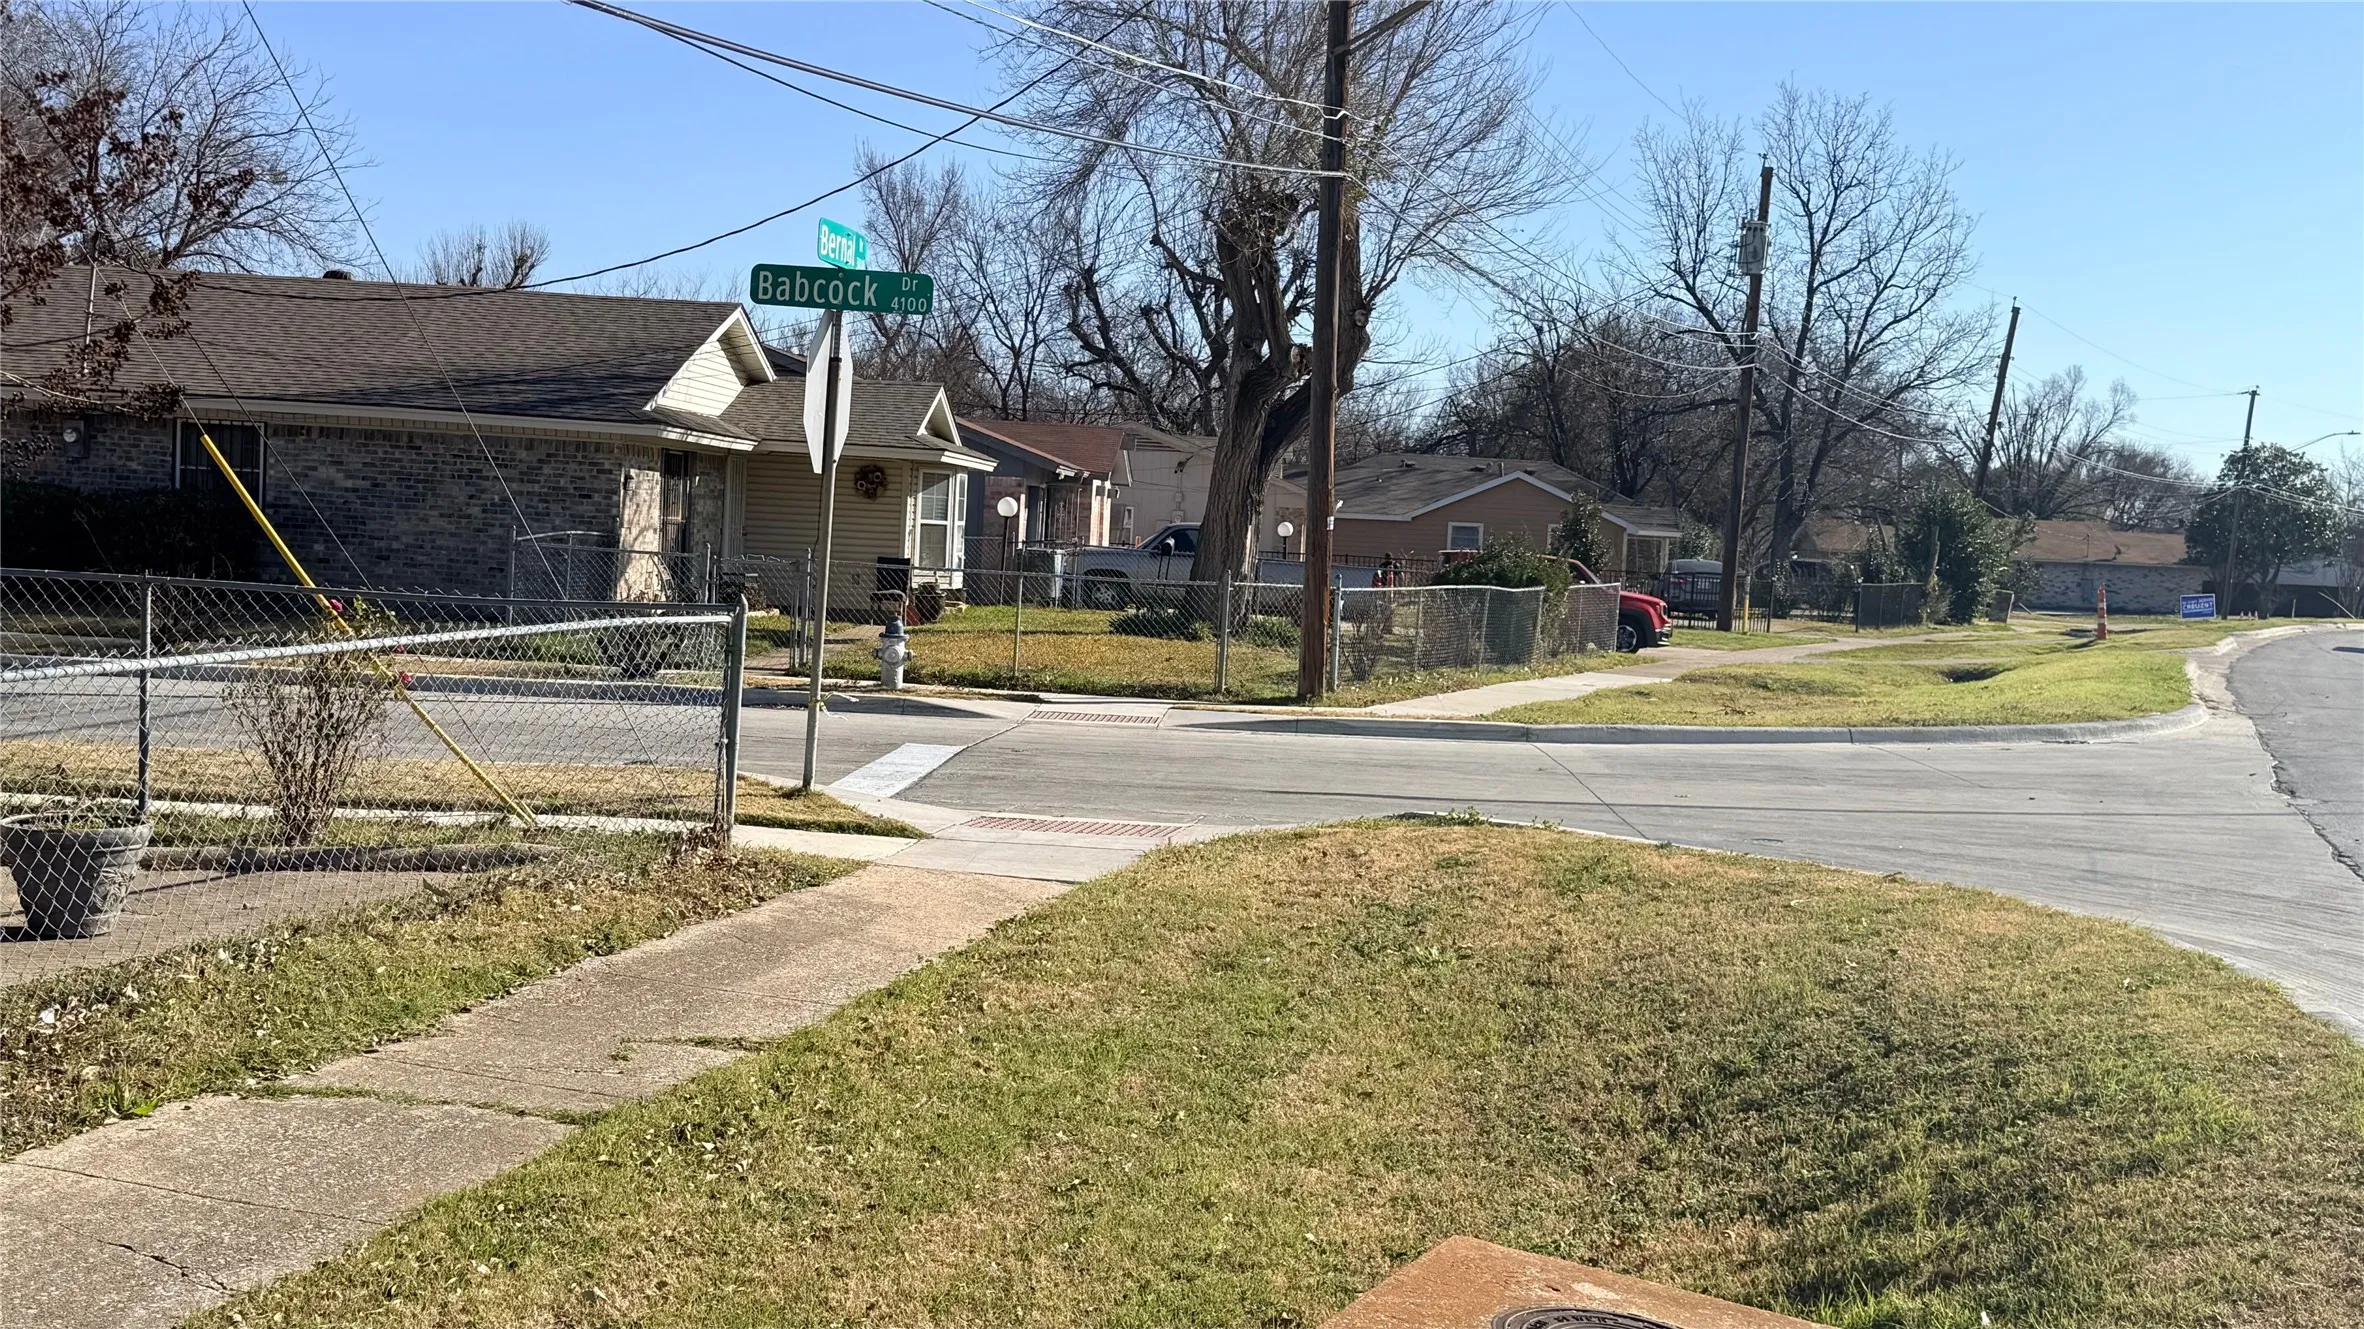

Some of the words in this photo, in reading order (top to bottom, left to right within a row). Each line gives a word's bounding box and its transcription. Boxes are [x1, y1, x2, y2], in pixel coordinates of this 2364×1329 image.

[820, 225, 856, 267] Bernal
[758, 271, 878, 306] Babcock
[902, 277, 918, 292] Dr
[891, 297, 927, 312] 4100
